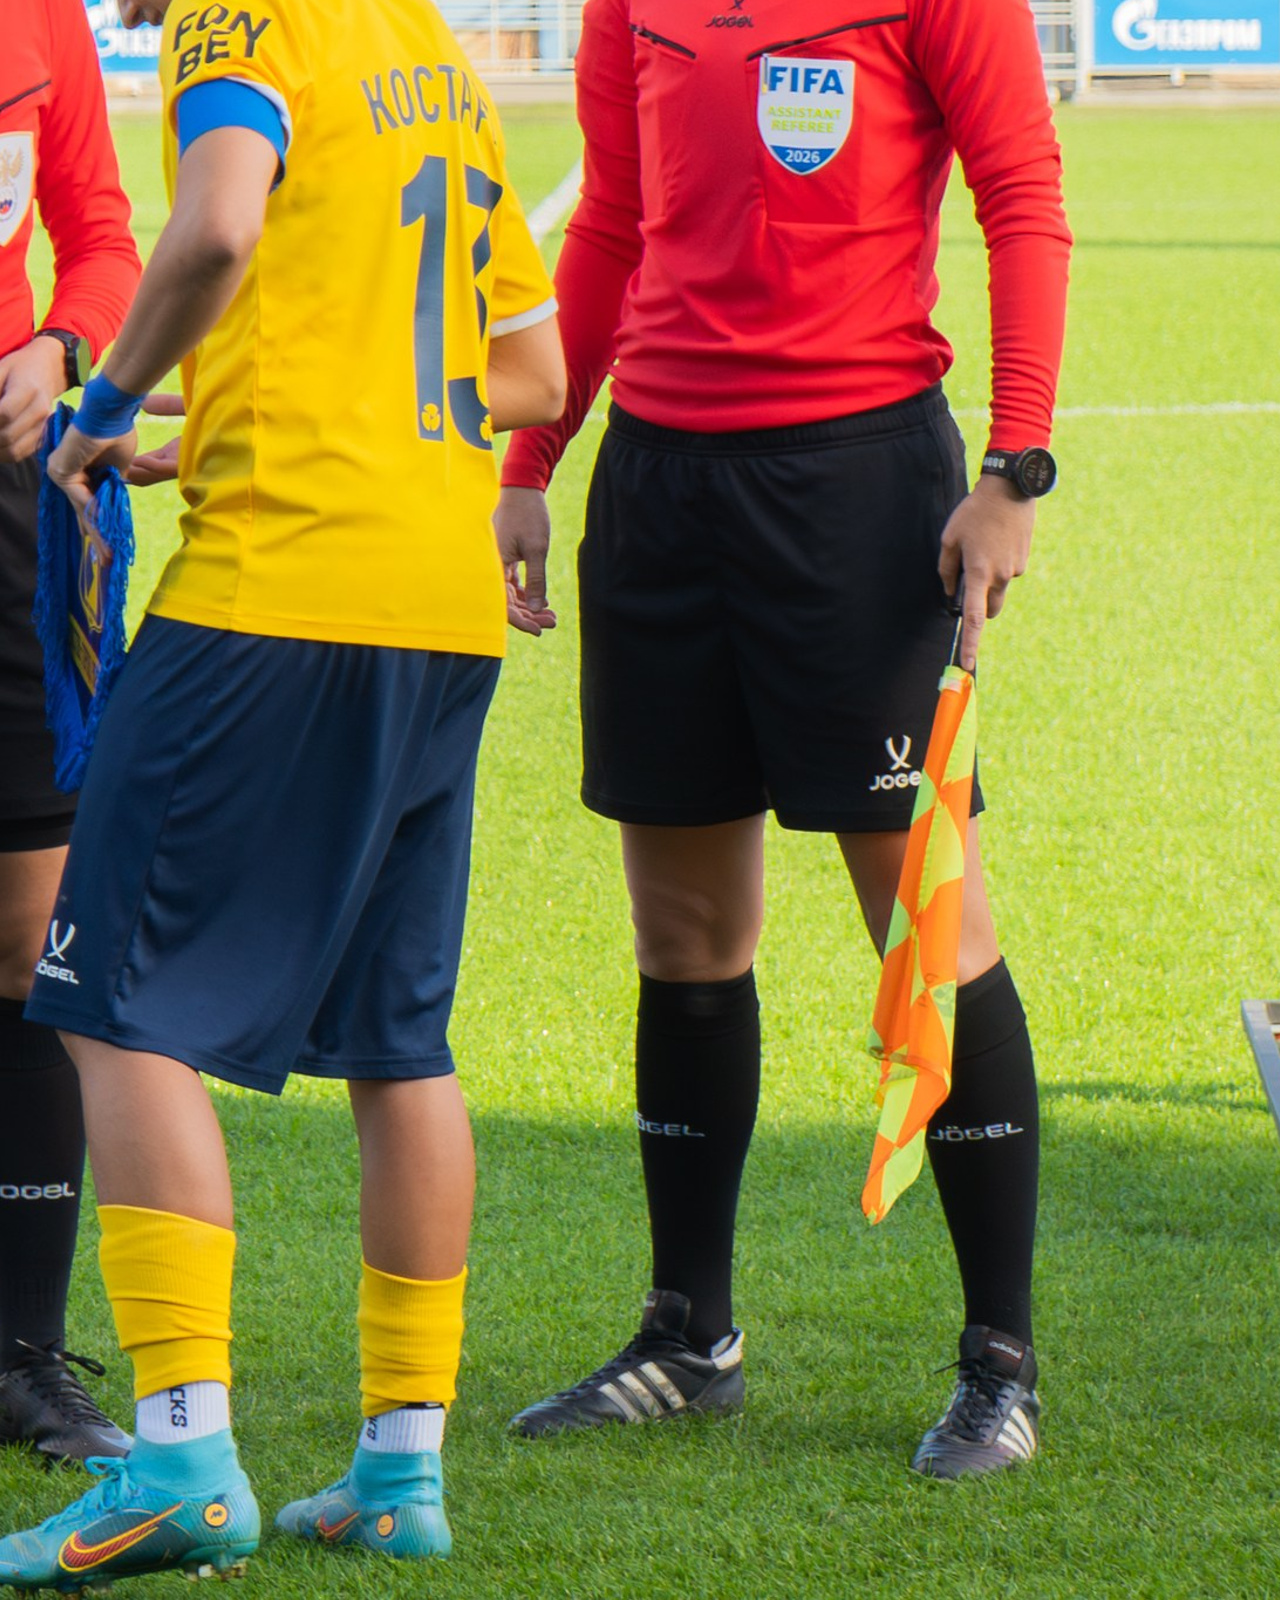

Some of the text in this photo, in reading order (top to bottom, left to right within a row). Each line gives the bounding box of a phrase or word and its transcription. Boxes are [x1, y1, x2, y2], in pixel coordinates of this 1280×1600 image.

[768, 65, 845, 95] FIFA
[767, 105, 843, 120] ASSISTANT
[770, 118, 836, 134] REFEREE
[785, 149, 821, 164] 2026
[633, 1111, 705, 1138] ÖGEL
[169, 1384, 189, 1429] CKS
